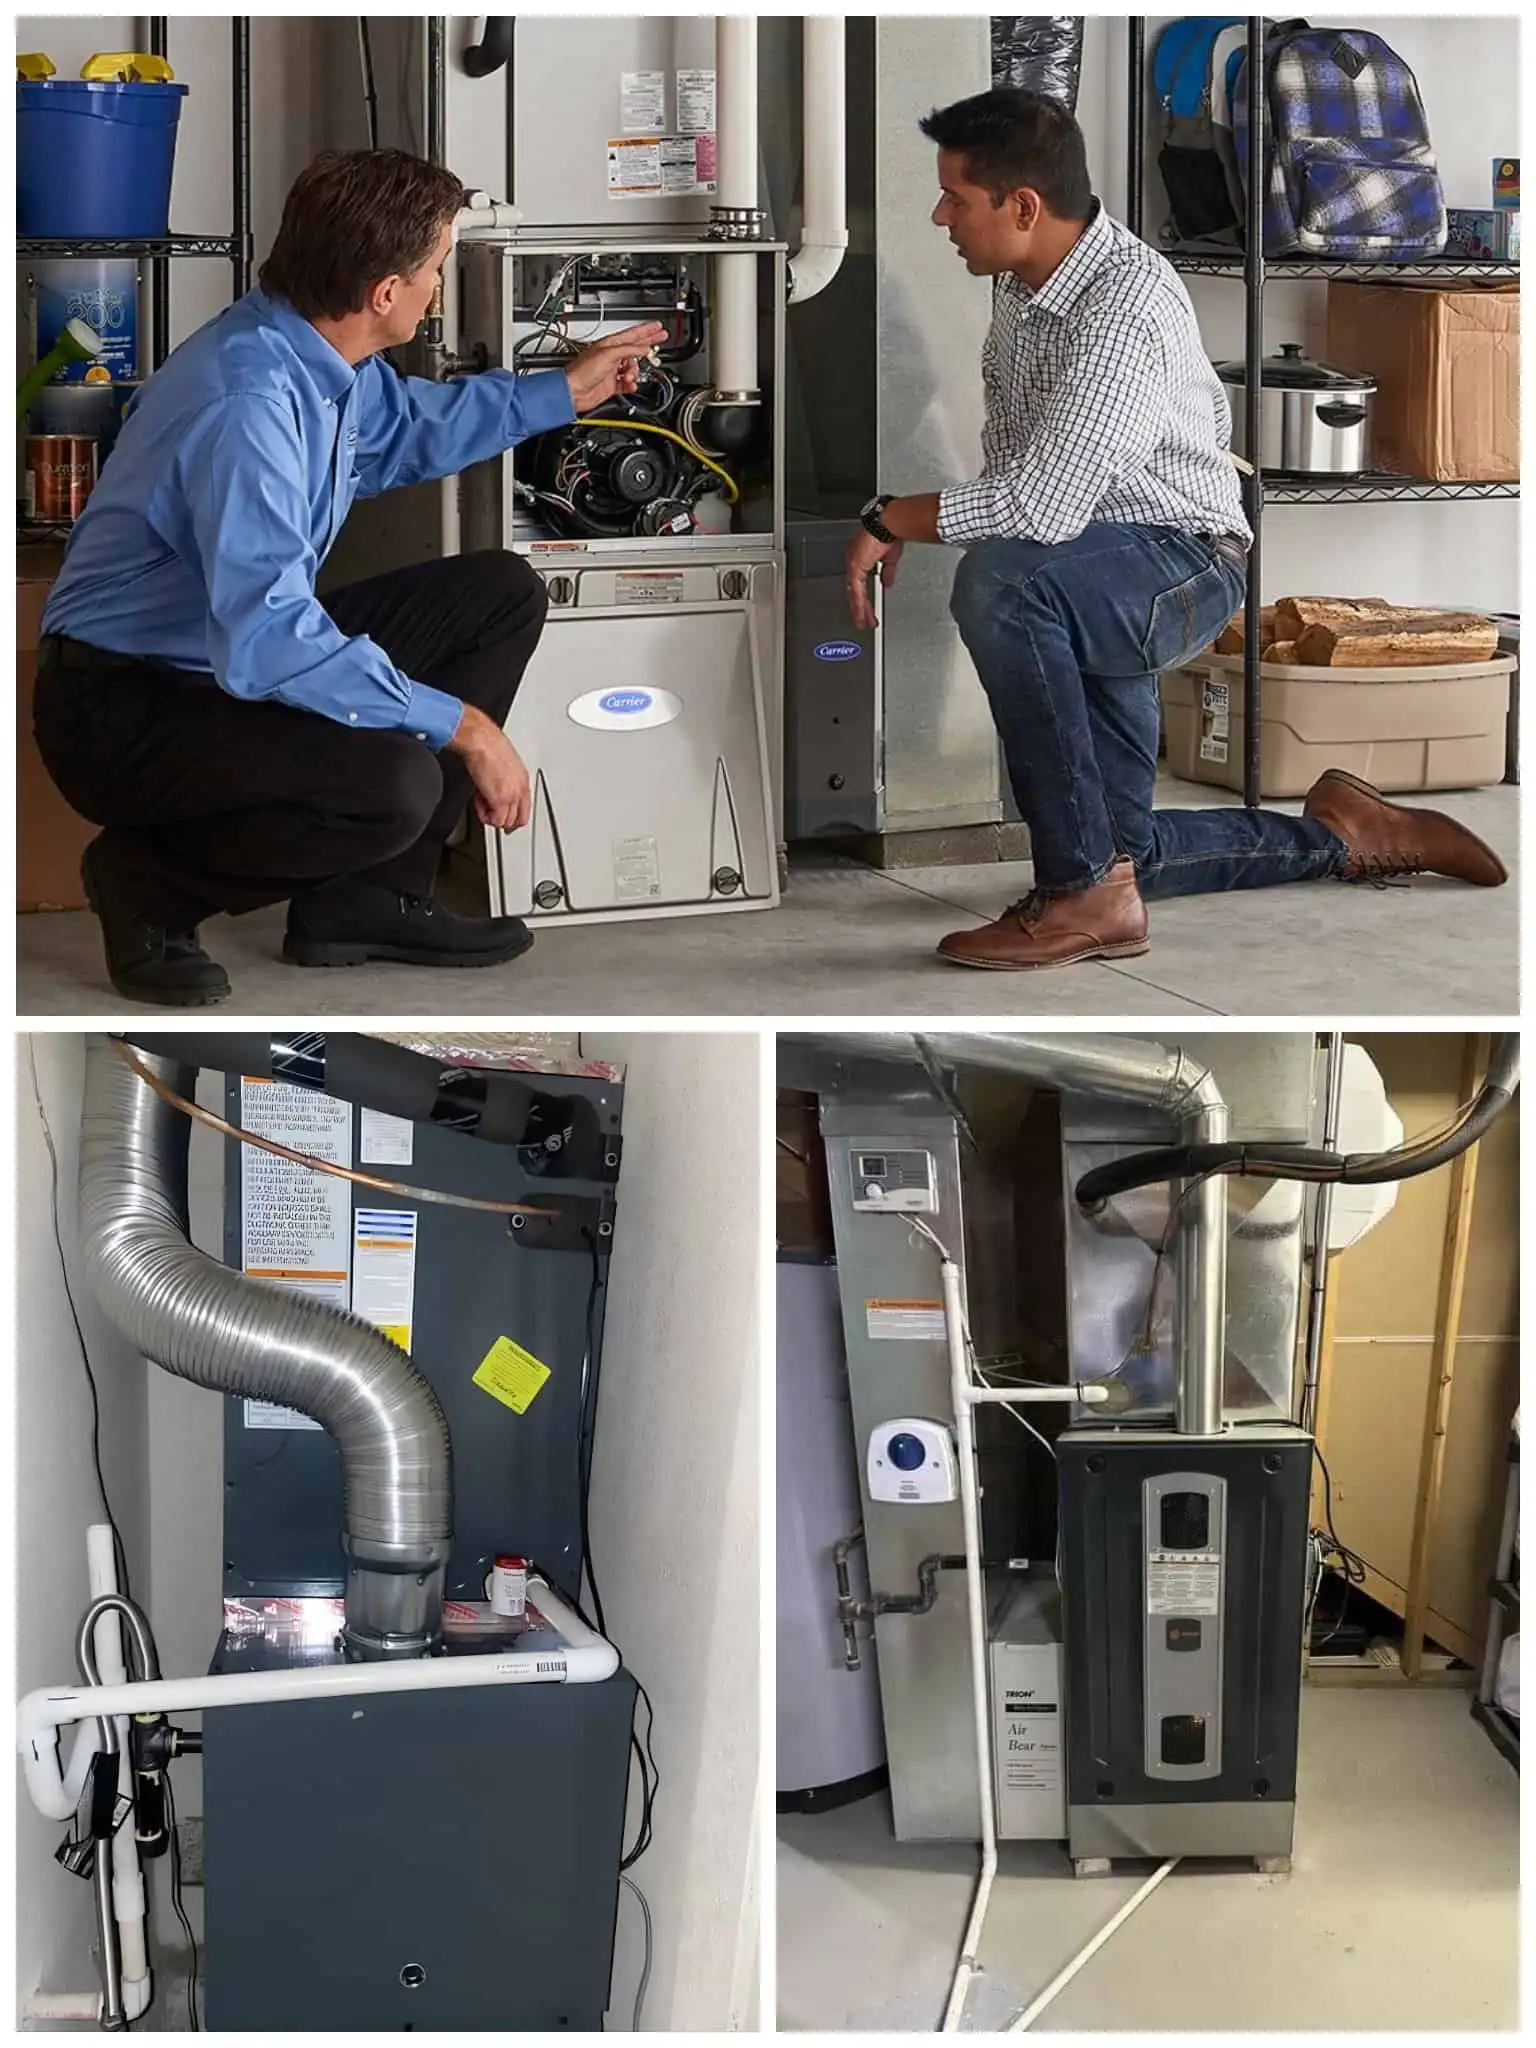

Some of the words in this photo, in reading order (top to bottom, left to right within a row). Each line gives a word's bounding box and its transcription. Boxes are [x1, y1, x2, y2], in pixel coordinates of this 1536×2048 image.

[819, 645, 856, 656] Carrier
[606, 695, 646, 708] Carrier
[1007, 1723, 1028, 1736] Air
[1008, 1739, 1036, 1751] Bear
